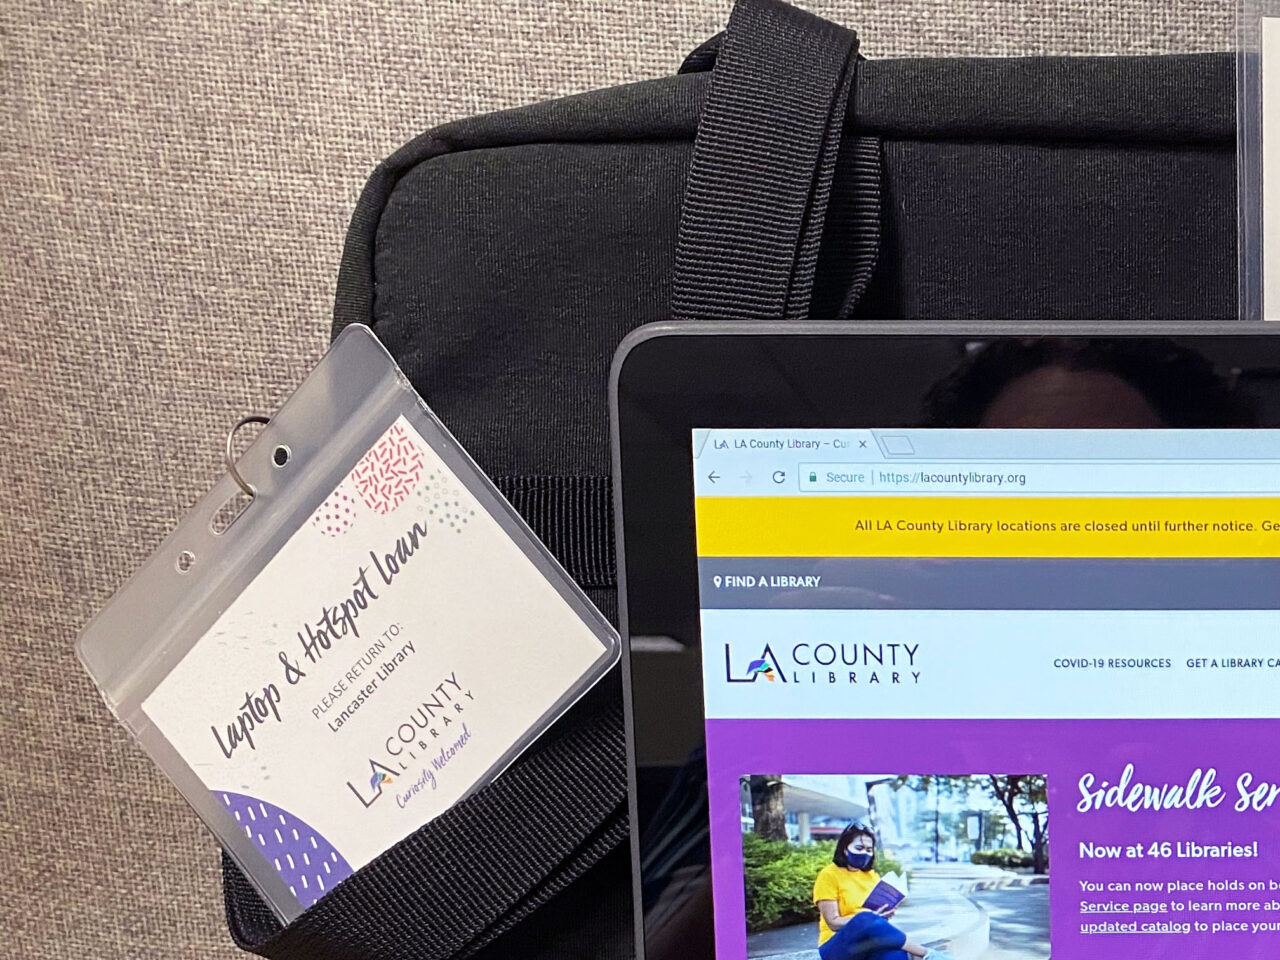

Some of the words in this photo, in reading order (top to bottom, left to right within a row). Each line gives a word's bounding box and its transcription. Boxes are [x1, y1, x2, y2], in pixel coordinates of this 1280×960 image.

[749, 438, 786, 452] County
[787, 438, 821, 452] Library
[826, 471, 866, 483] Secure
[878, 471, 1027, 487] https://lacountylibrary.org
[854, 519, 873, 531] All
[876, 519, 893, 531] LA
[896, 519, 944, 534] County
[947, 519, 993, 534] Library
[996, 520, 1057, 532] locations
[1060, 522, 1081, 532] are
[1084, 519, 1128, 533] closed
[1131, 520, 1161, 532] until
[1164, 520, 1209, 532] further
[1212, 520, 1258, 532] notice.
[724, 575, 756, 588] FIND
[758, 575, 769, 588] A
[770, 574, 822, 588] LIBRARY
[210, 683, 282, 759] Laptop
[278, 650, 306, 686] &
[297, 566, 380, 664] Hotspot
[369, 520, 428, 586] Loan
[311, 678, 349, 720] PLEASE
[345, 639, 386, 684] RETURN
[382, 621, 404, 643] TO:
[724, 642, 788, 683] LA
[792, 642, 920, 666] COUNTY
[793, 671, 921, 684] LIBRARY
[1053, 658, 1105, 668] COVID-19
[1108, 658, 1172, 668] RESOURCES
[1186, 658, 1208, 668] GET
[1210, 658, 1219, 668] A
[1221, 658, 1264, 668] LIBRARY
[327, 678, 379, 733] Lancaster
[375, 640, 417, 682] Library
[346, 758, 401, 809] LA
[385, 671, 462, 756] COUNTY
[398, 689, 475, 771] LIBRARY
[395, 768, 438, 809] Curiosity
[430, 721, 472, 772] Welcomed
[1076, 763, 1227, 813] Sidewalk
[1079, 841, 1124, 859] Now
[1125, 843, 1144, 859] at
[1147, 841, 1172, 859] 46
[1176, 840, 1258, 858] Libraries!
[1079, 919, 1138, 934] updated
[1140, 919, 1191, 934] catalog
[1194, 920, 1209, 931] to
[1212, 919, 1249, 934] place
